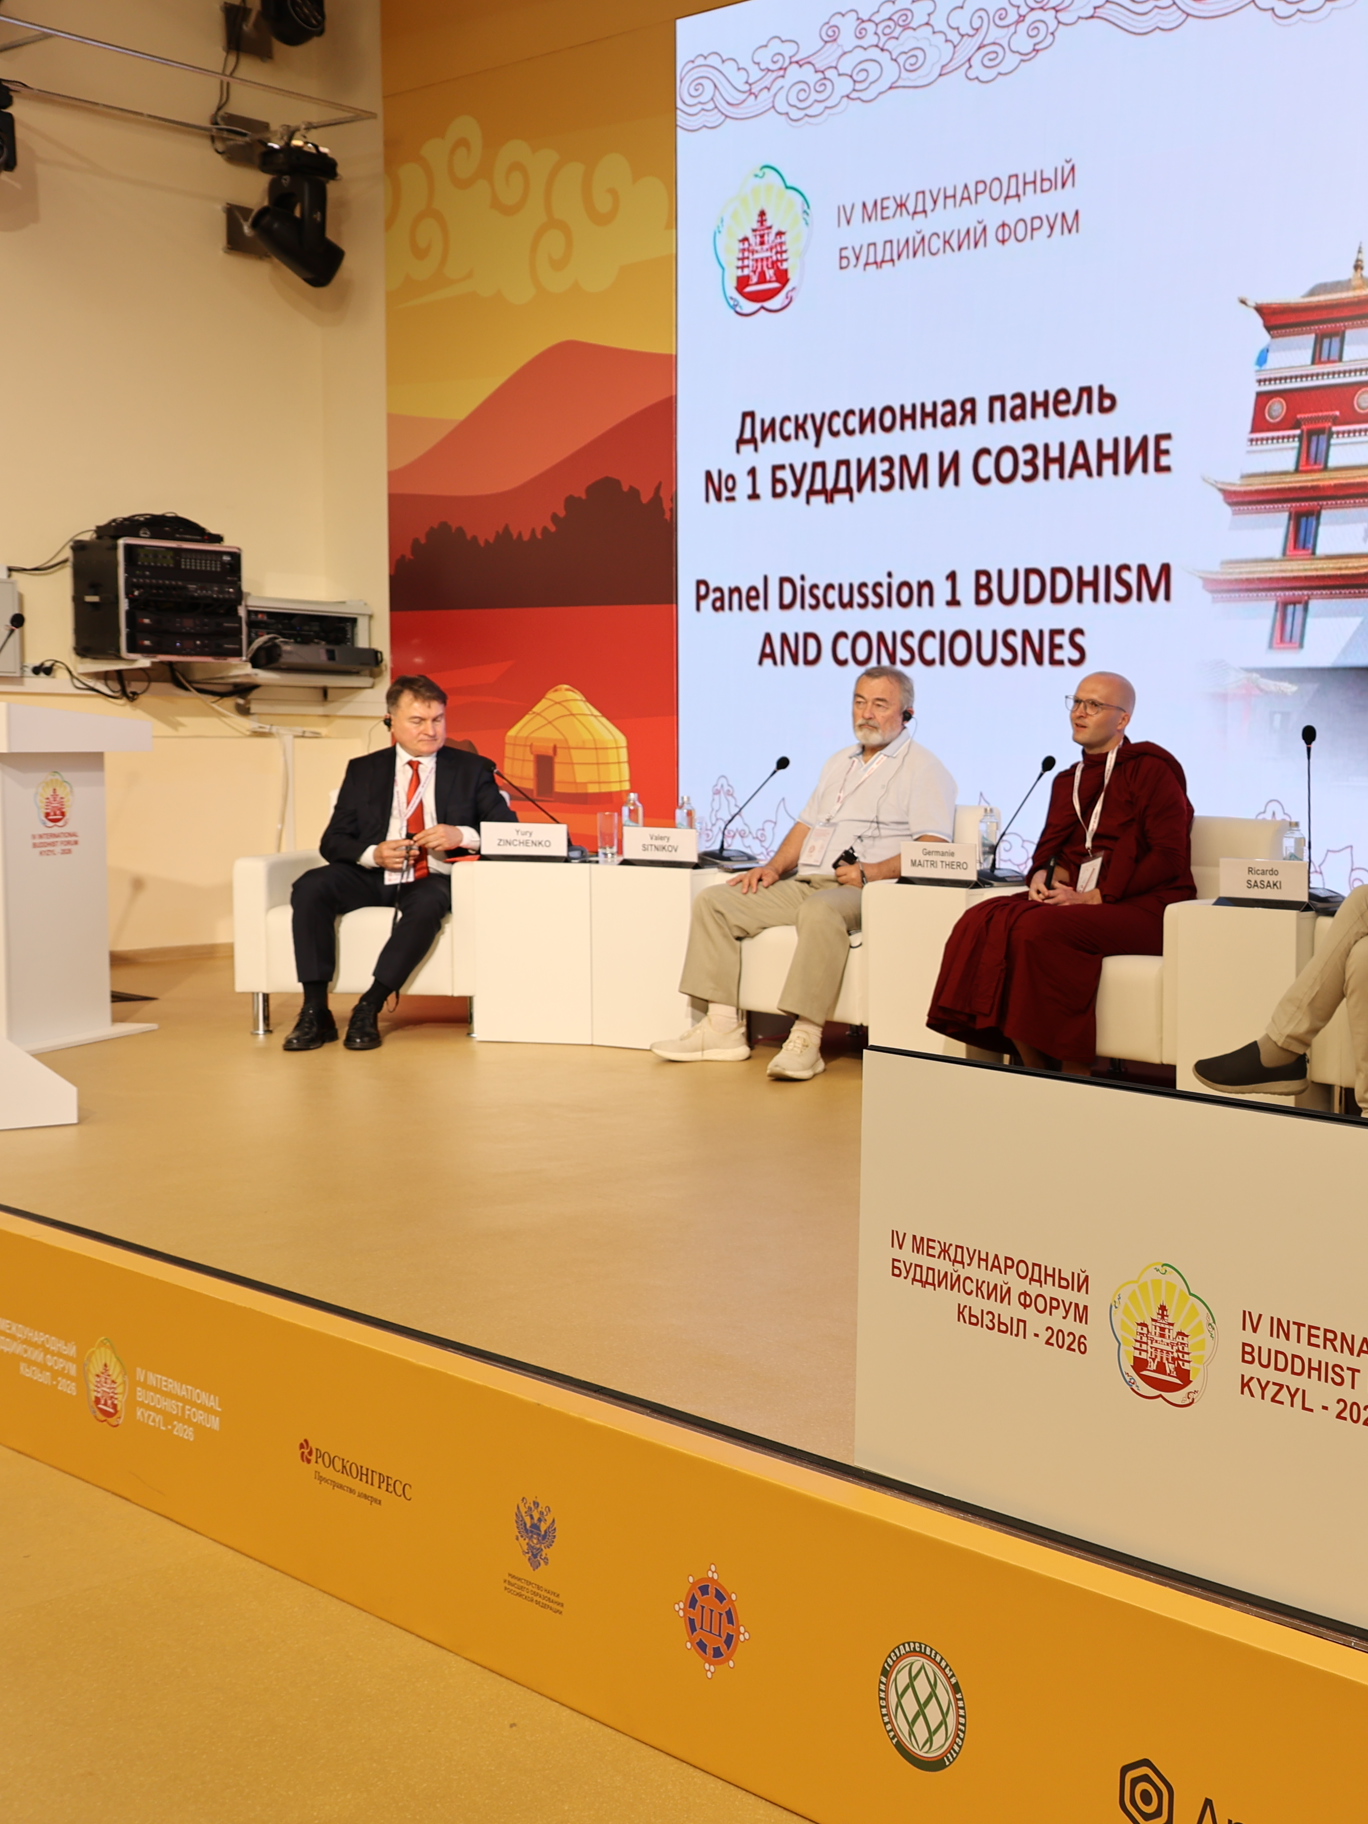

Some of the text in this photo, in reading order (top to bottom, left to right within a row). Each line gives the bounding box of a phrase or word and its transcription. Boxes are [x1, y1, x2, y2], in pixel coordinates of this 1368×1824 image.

[837, 158, 1075, 228] IV МЕЖДУНАРОДНЫЙ
[839, 209, 1079, 271] БУДДИЙСКИЙ ФОРУМ
[736, 384, 1117, 452] Дискуссионная панель
[704, 433, 1172, 505] № 1 БУДДИЗМ И СОЗНАНИЕ
[695, 563, 1172, 612] Panel Discussion 1 BUDDHISM
[758, 628, 1087, 667] AND CONSCIOUSNES
[497, 838, 551, 848] ZINCHENKO
[515, 829, 533, 838] Yury
[641, 843, 679, 853] SITNIKOV
[649, 833, 670, 843] Valery
[922, 848, 955, 857] Germanie
[911, 859, 968, 870] MAITRI THERO
[1247, 867, 1279, 876] Ricardo
[1246, 879, 1282, 890] SASAKI
[891, 1229, 1089, 1295] IV МЕЖДУНАРОДНЫЙ
[891, 1257, 1089, 1325] БУДДИЙСКИЙ ФОРУМ
[957, 1303, 1027, 1339] КЫЗЫЛ
[1044, 1325, 1088, 1355] 2026
[1241, 1309, 1263, 1334] IV
[19, 1361, 52, 1386] КЫЗЫЛ
[57, 1376, 77, 1396] 2026
[45, 1353, 77, 1377] ФОРУМ
[1241, 1342, 1361, 1390] BUDDHIST
[136, 1367, 222, 1411] IV INTERNATIONAL
[1240, 1373, 1314, 1413] KYZYL
[136, 1387, 220, 1431] BUDDHIST FORUM
[136, 1406, 166, 1430] KYZYL
[173, 1421, 194, 1441] 2026
[314, 1447, 412, 1501] РОСКОНГРЕСС
[314, 1470, 382, 1506] Пространство доверия
